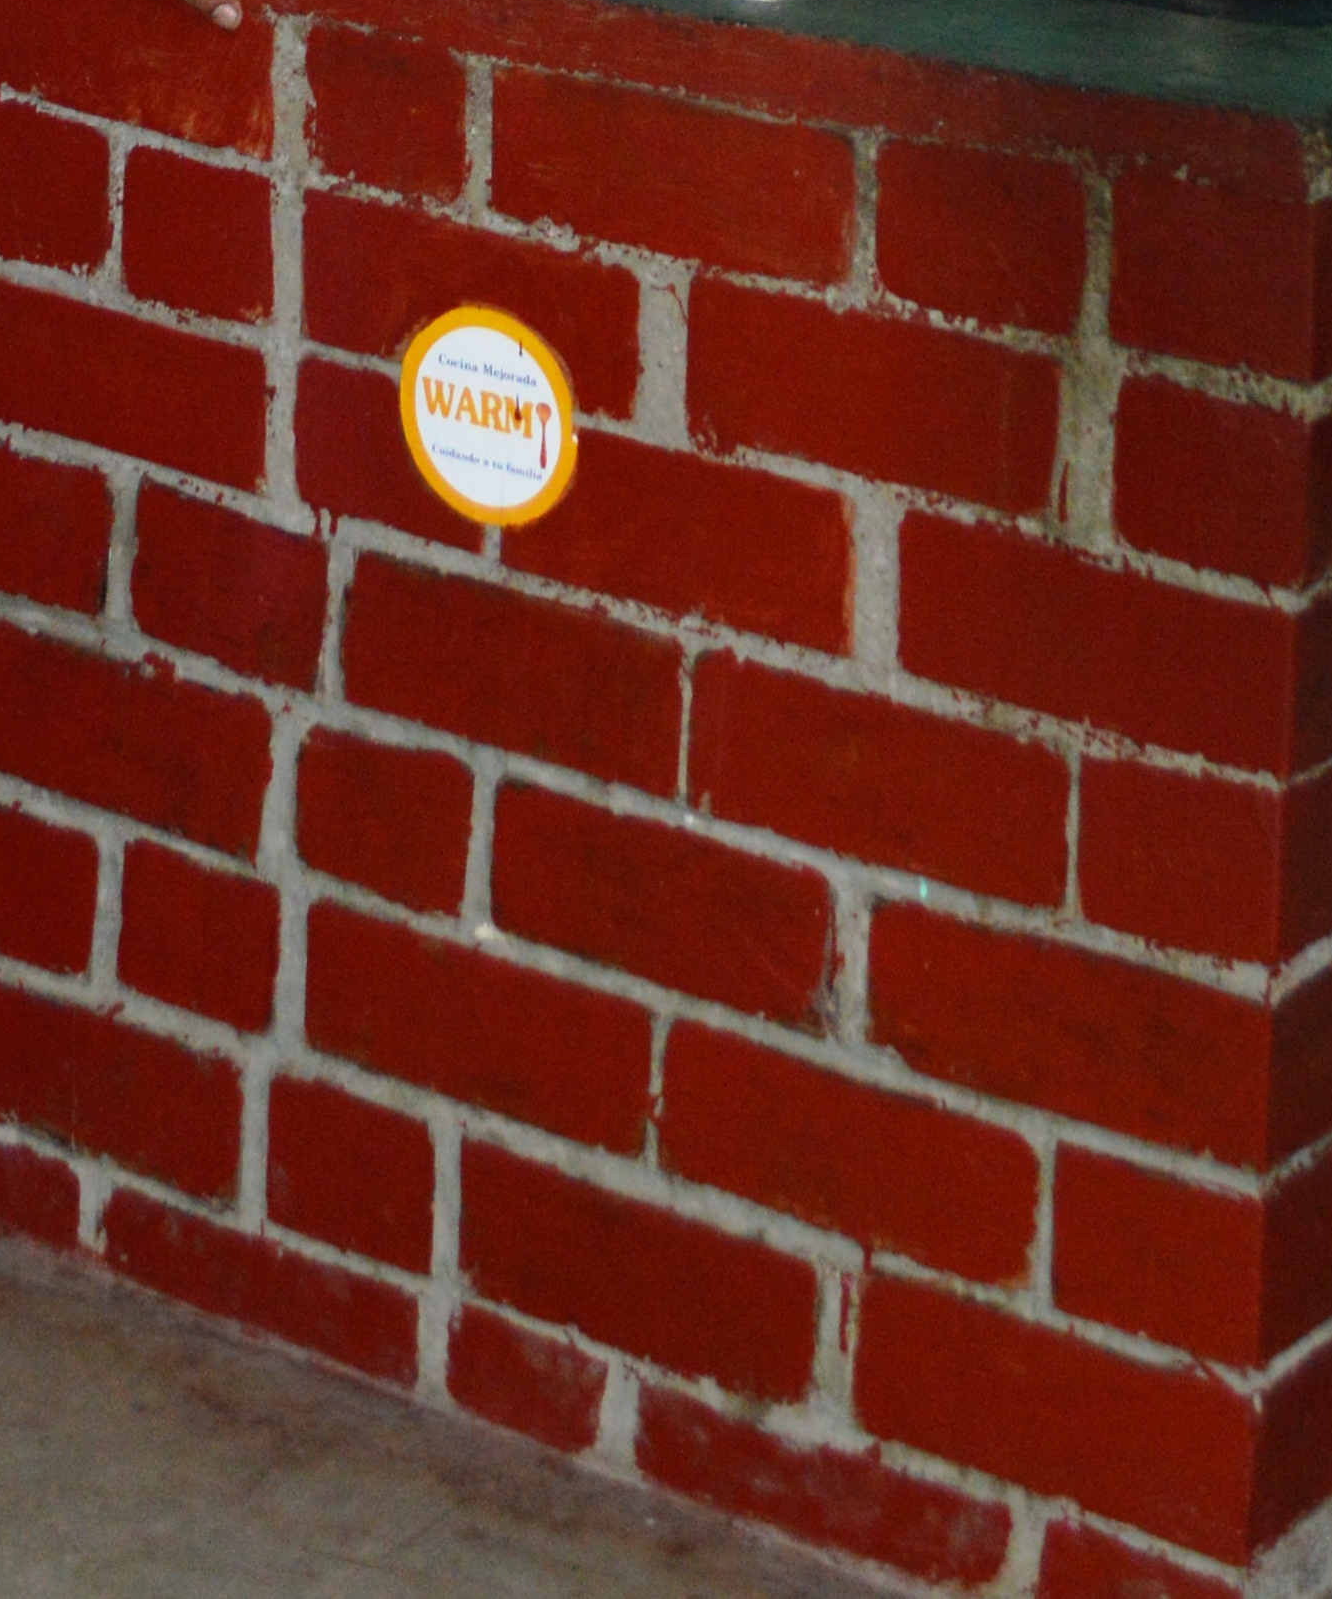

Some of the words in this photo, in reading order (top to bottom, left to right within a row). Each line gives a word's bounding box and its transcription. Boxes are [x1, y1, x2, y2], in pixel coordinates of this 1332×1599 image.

[438, 353, 479, 373] Cocina
[482, 364, 537, 388] Mejorada
[431, 442, 481, 465] Cuidando
[483, 457, 490, 467] a
[505, 462, 543, 481] familia
